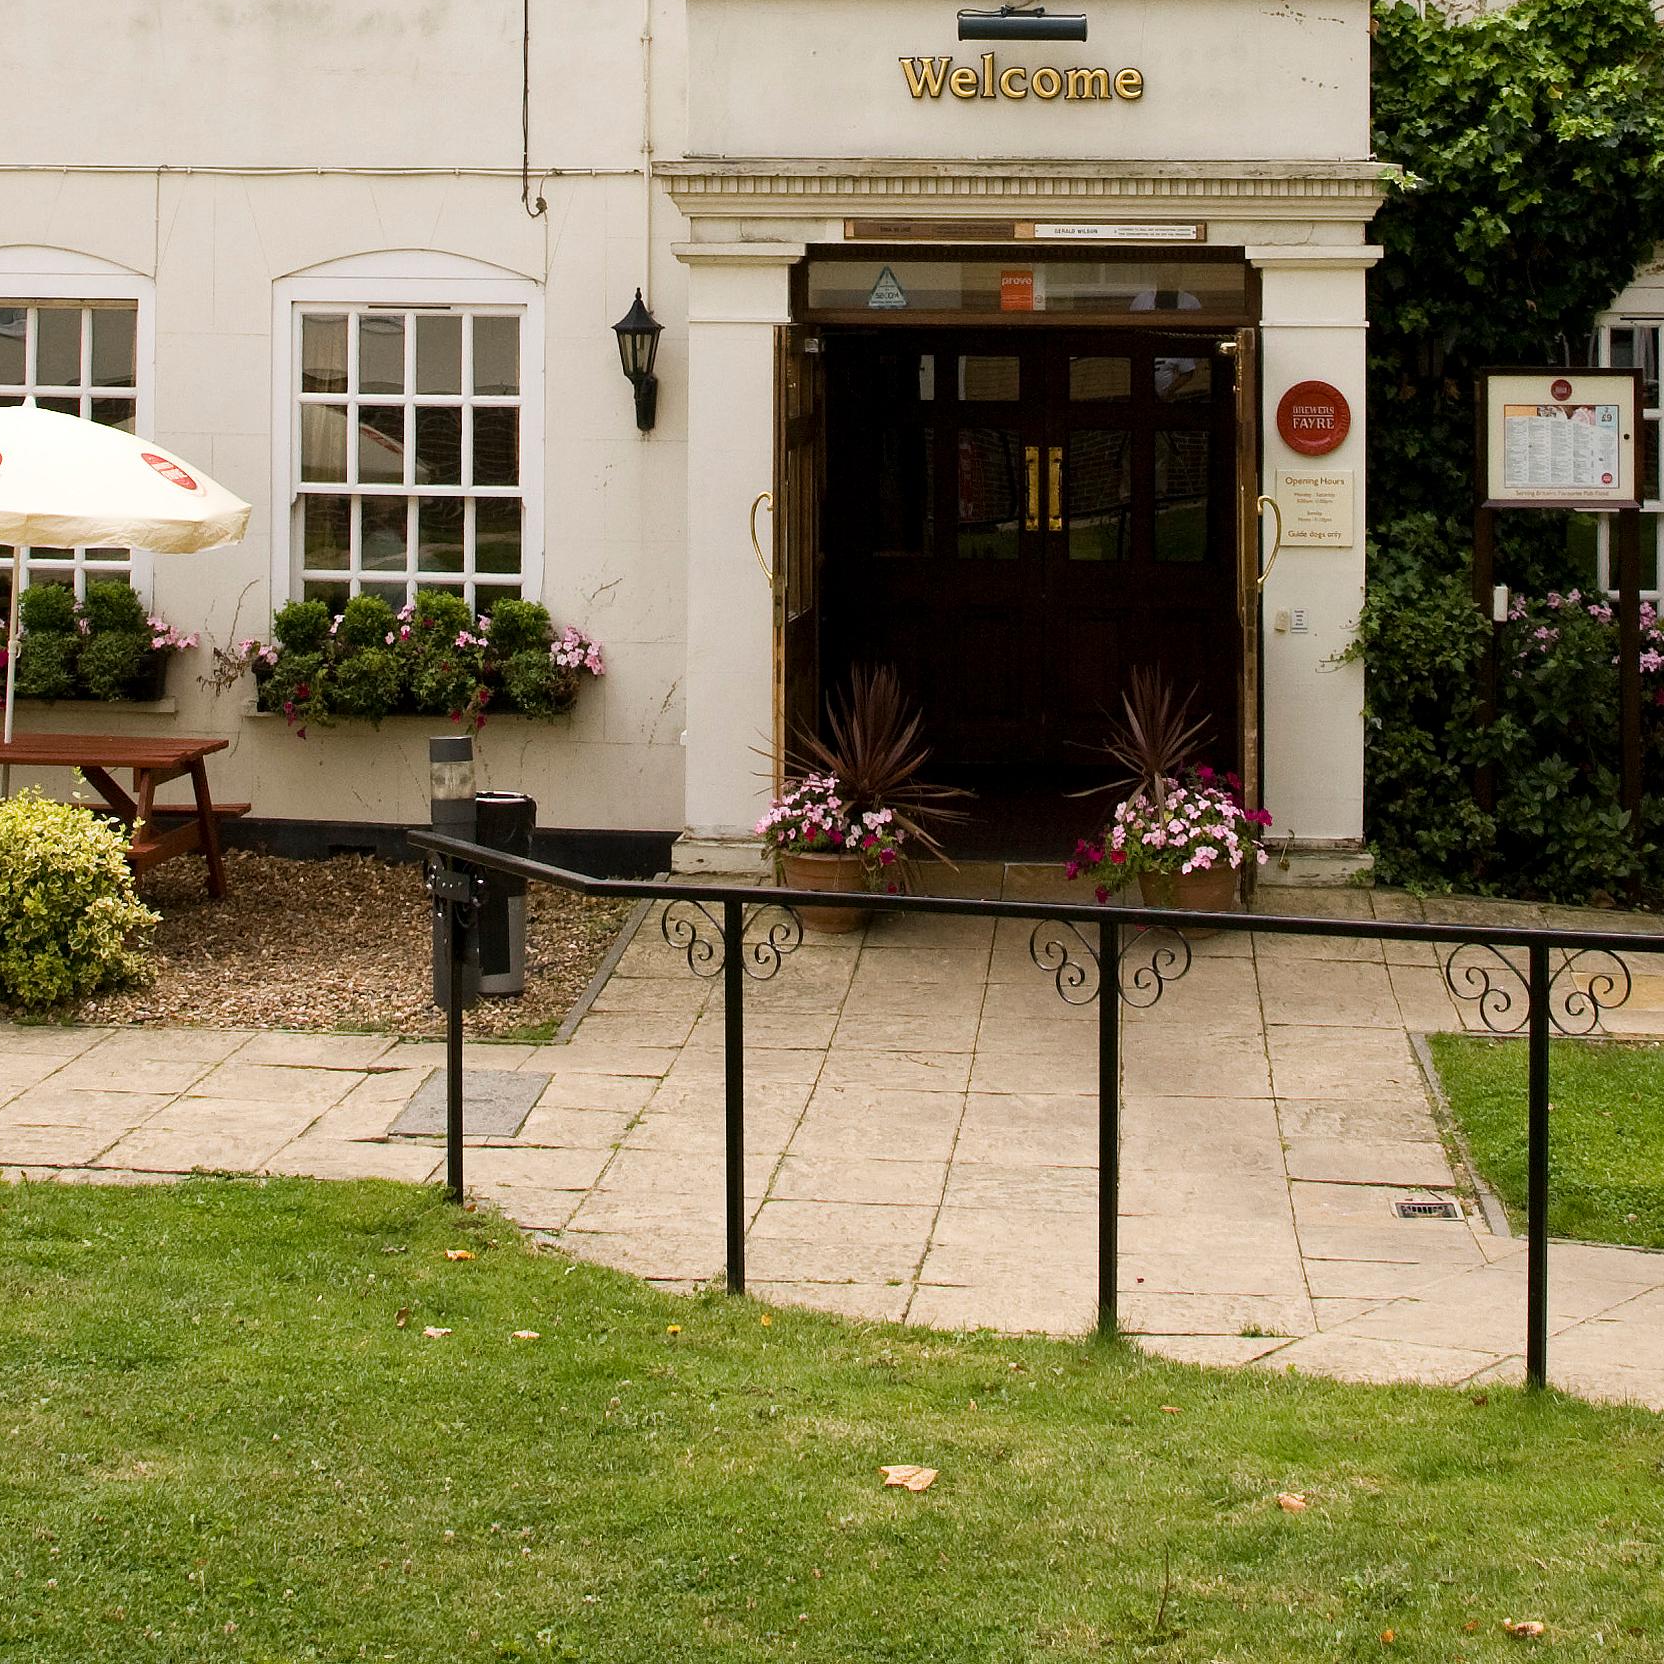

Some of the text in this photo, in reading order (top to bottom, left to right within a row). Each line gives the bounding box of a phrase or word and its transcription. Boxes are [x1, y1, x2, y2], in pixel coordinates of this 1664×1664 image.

[898, 51, 1144, 99] Welcome
[1292, 406, 1335, 414] BREWERS
[1292, 417, 1335, 429] FAYRE
[1285, 476, 1345, 486] Opening Hours
[1288, 530, 1342, 540] Guide dogs only
